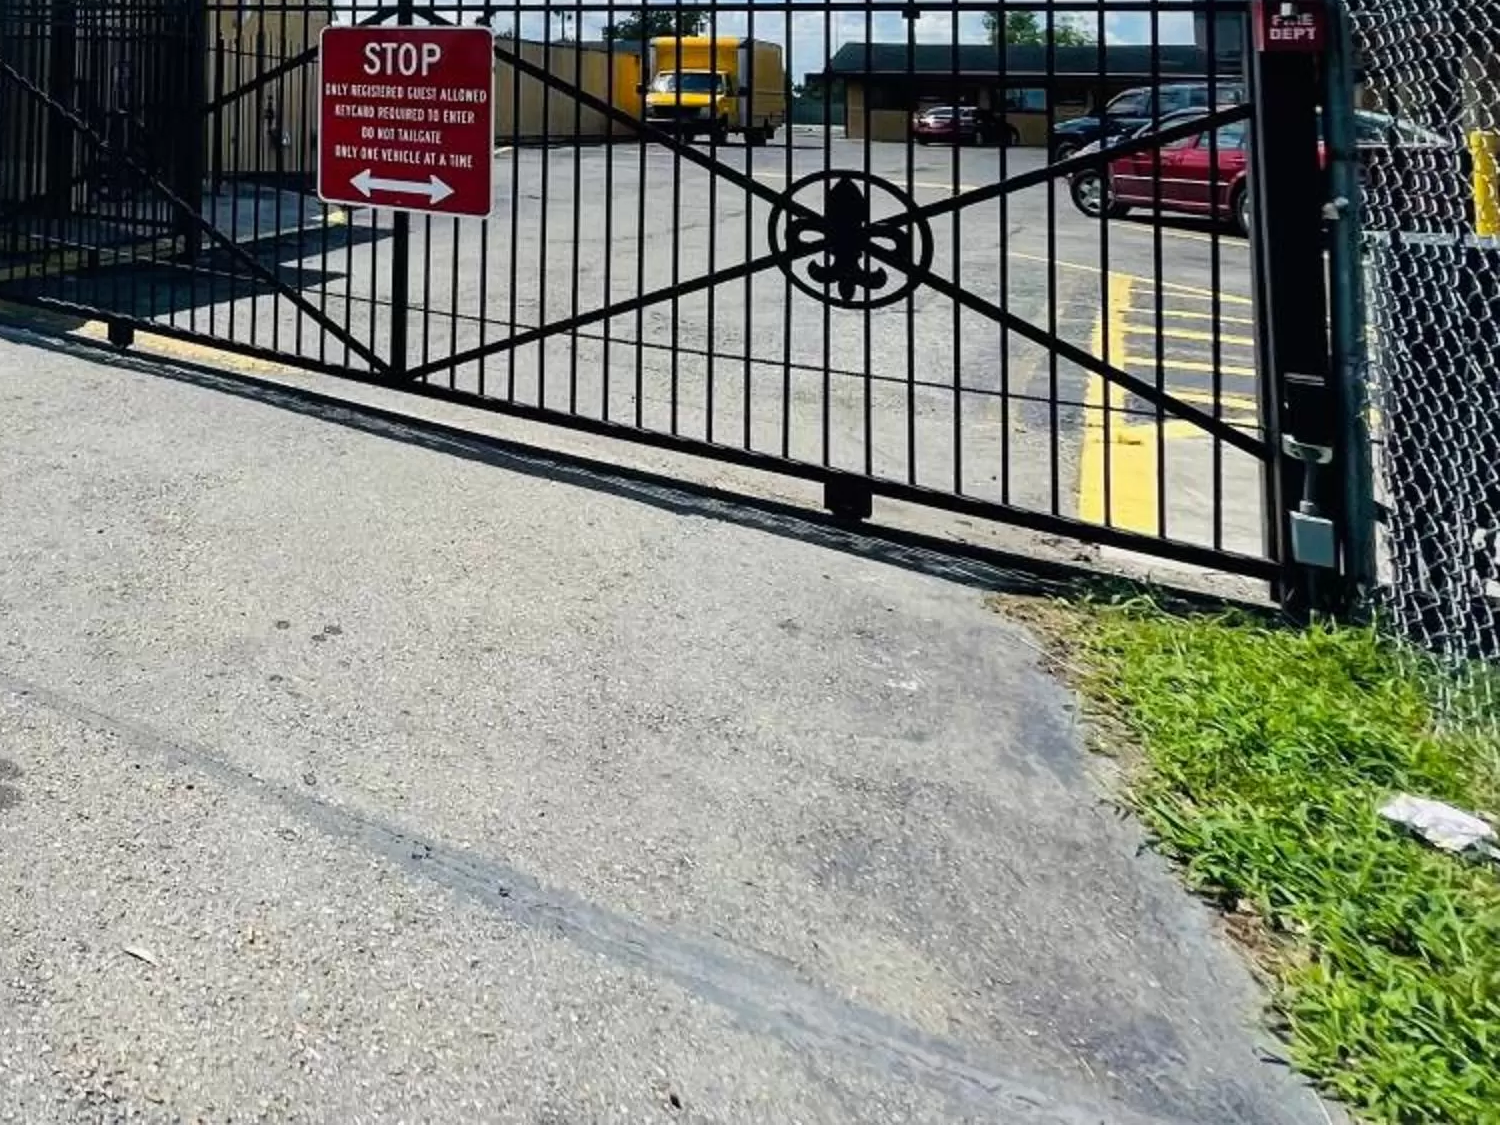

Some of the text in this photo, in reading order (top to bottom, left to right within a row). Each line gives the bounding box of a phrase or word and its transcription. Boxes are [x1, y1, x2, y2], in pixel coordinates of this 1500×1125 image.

[1270, 27, 1316, 40] DEPT
[363, 42, 442, 76] STOP
[325, 83, 487, 103] ONLY REGISTERED GUEST ALLOWED
[335, 104, 475, 124] KEYCARD REQUIRED TO ENTER
[361, 126, 443, 144] DO NOT TAILGATE
[335, 144, 474, 169] ONLY ONE VEHICLE AT A TIME
